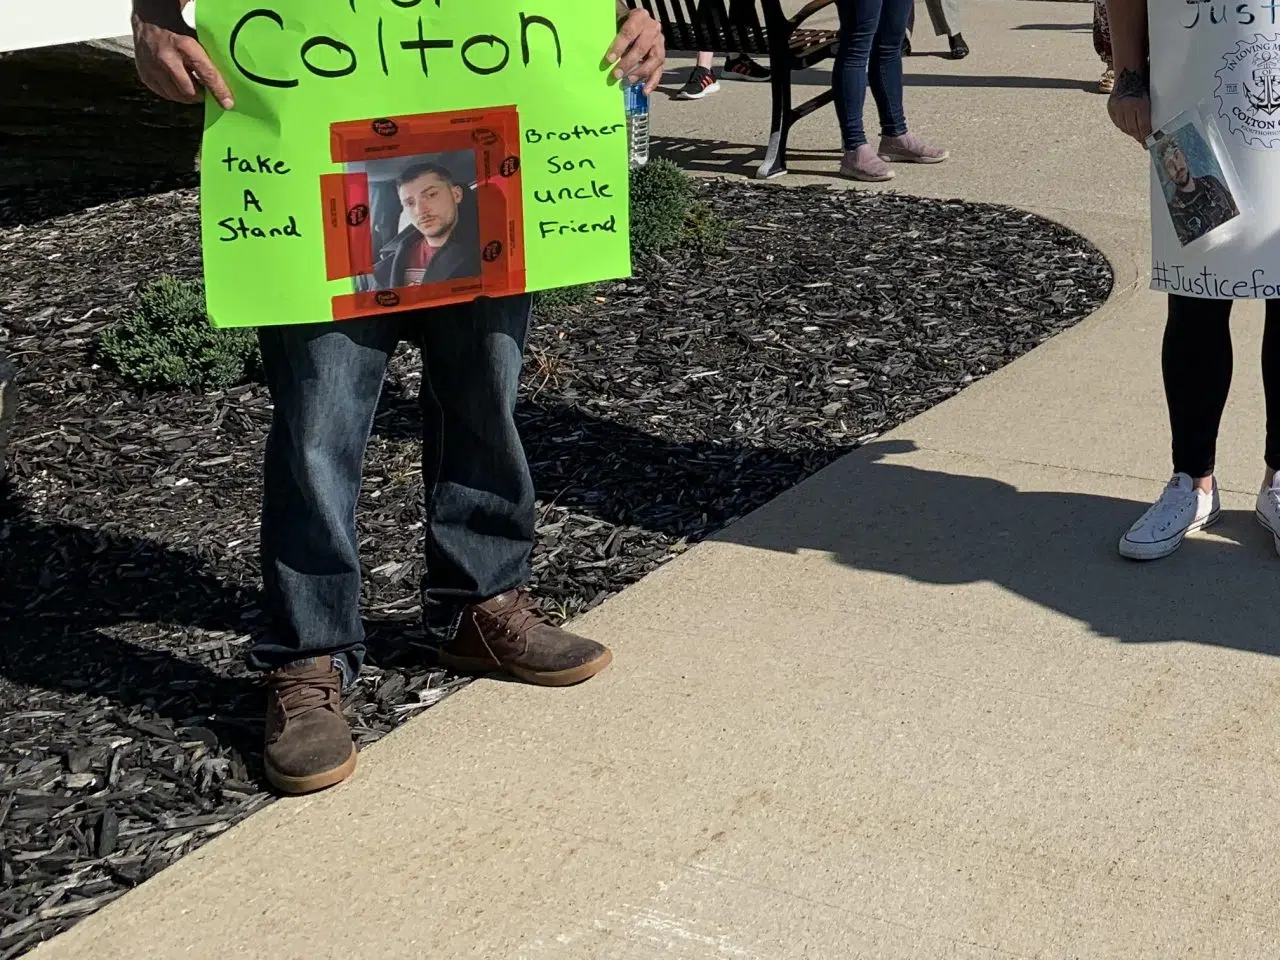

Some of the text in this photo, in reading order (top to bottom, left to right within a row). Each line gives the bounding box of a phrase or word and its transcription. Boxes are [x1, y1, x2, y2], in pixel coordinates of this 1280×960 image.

[229, 8, 562, 88] Colton
[1227, 59, 1238, 72] IN
[1236, 43, 1271, 61] LOVING
[1232, 106, 1275, 130] COLTON
[525, 124, 625, 143] Brother
[221, 146, 292, 175] take
[547, 155, 596, 174] Son
[243, 188, 263, 212] A
[217, 215, 302, 242] Stand
[539, 215, 617, 238] Friend
